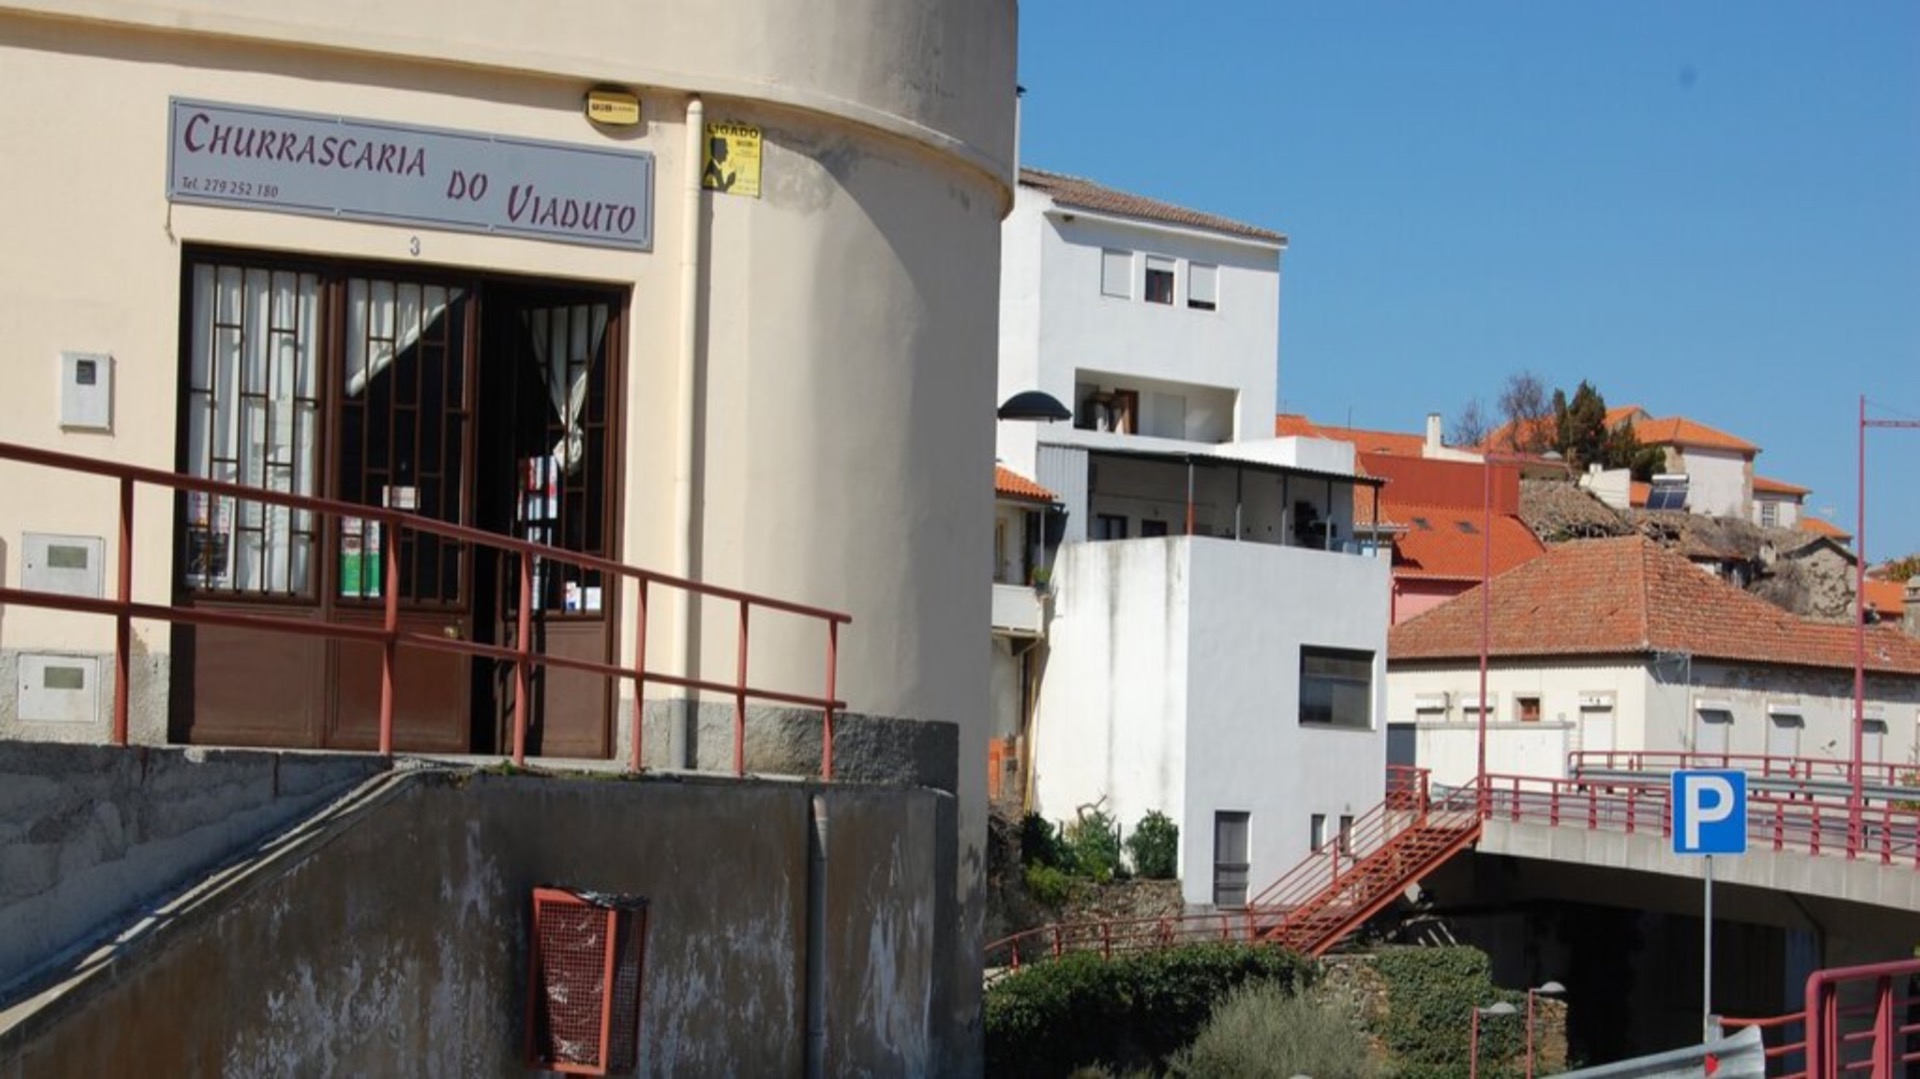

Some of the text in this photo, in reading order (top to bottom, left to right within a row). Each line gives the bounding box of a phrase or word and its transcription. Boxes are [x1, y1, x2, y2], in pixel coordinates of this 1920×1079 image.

[706, 122, 759, 139] LIGADO
[184, 113, 636, 234] CHURRASCARIA DO VIADUTO
[204, 178, 227, 193] 279
[230, 180, 253, 196] 252
[257, 183, 278, 198] 180
[410, 236, 421, 257] 3
[1685, 775, 1734, 849] P
